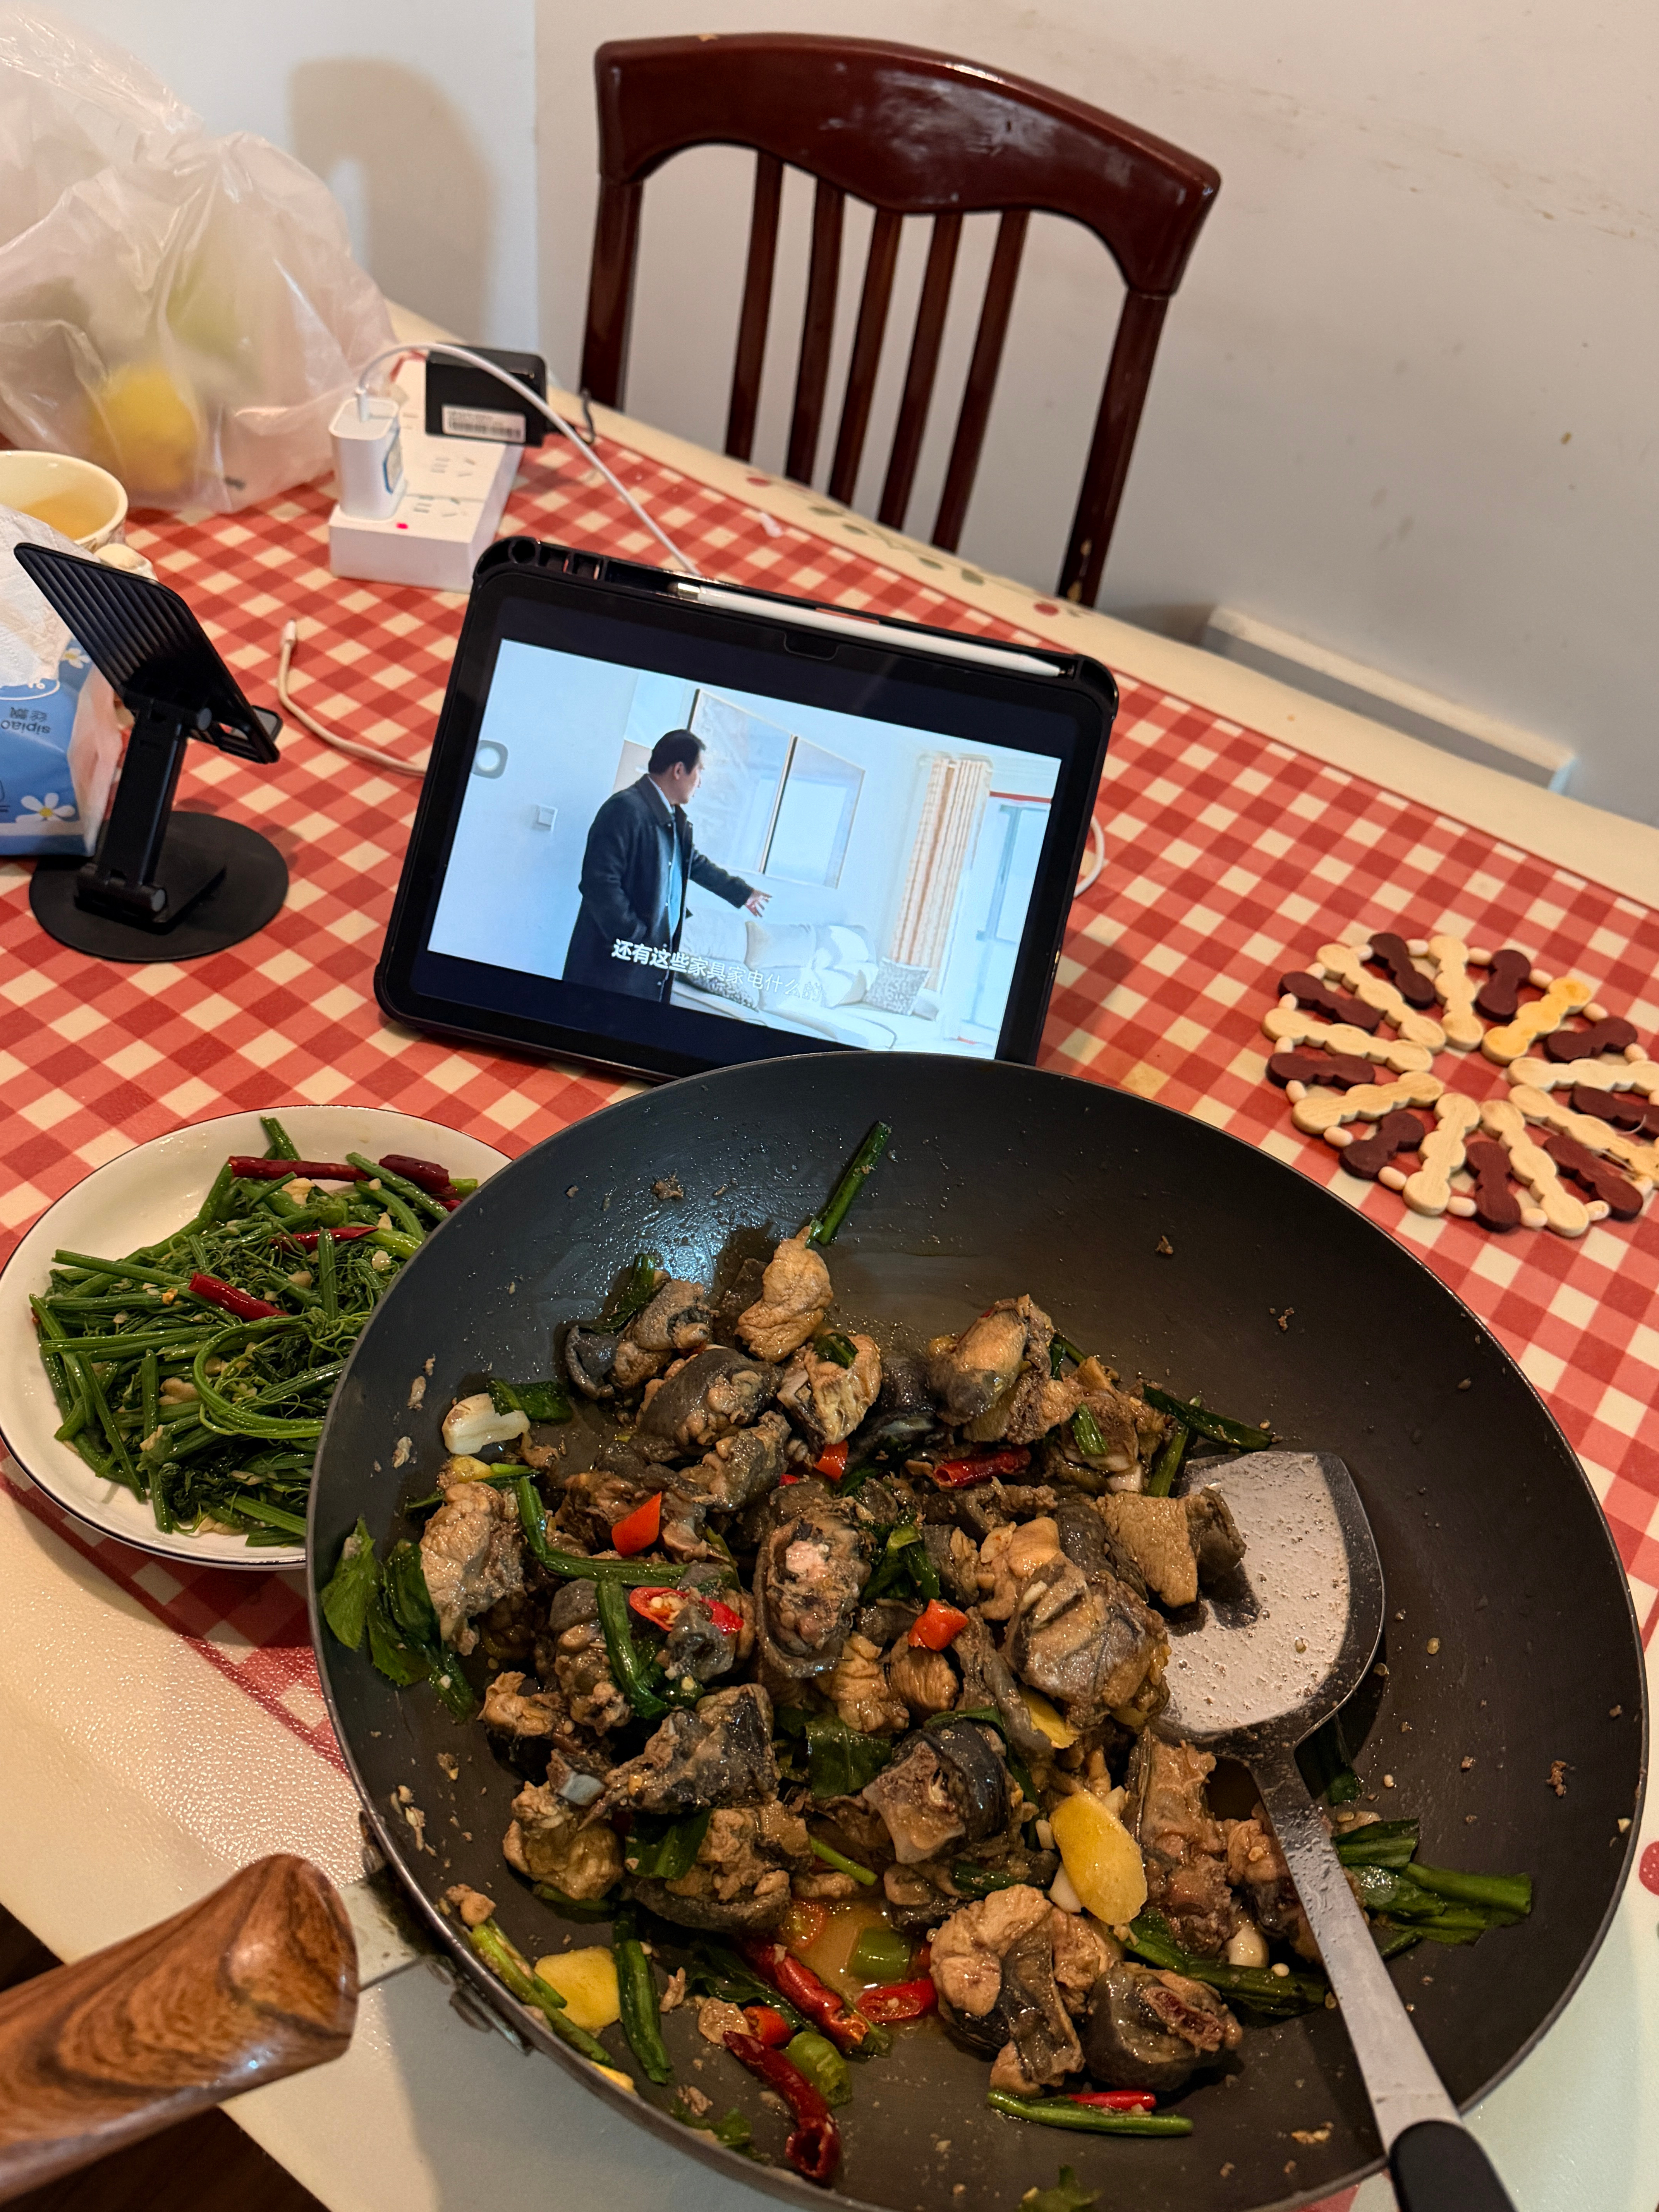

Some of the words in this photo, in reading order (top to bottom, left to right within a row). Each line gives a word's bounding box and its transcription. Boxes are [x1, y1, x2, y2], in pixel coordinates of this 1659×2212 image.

[0, 720, 51, 735] sipiao
[611, 938, 822, 1001] 还有这些家具家电什么的
